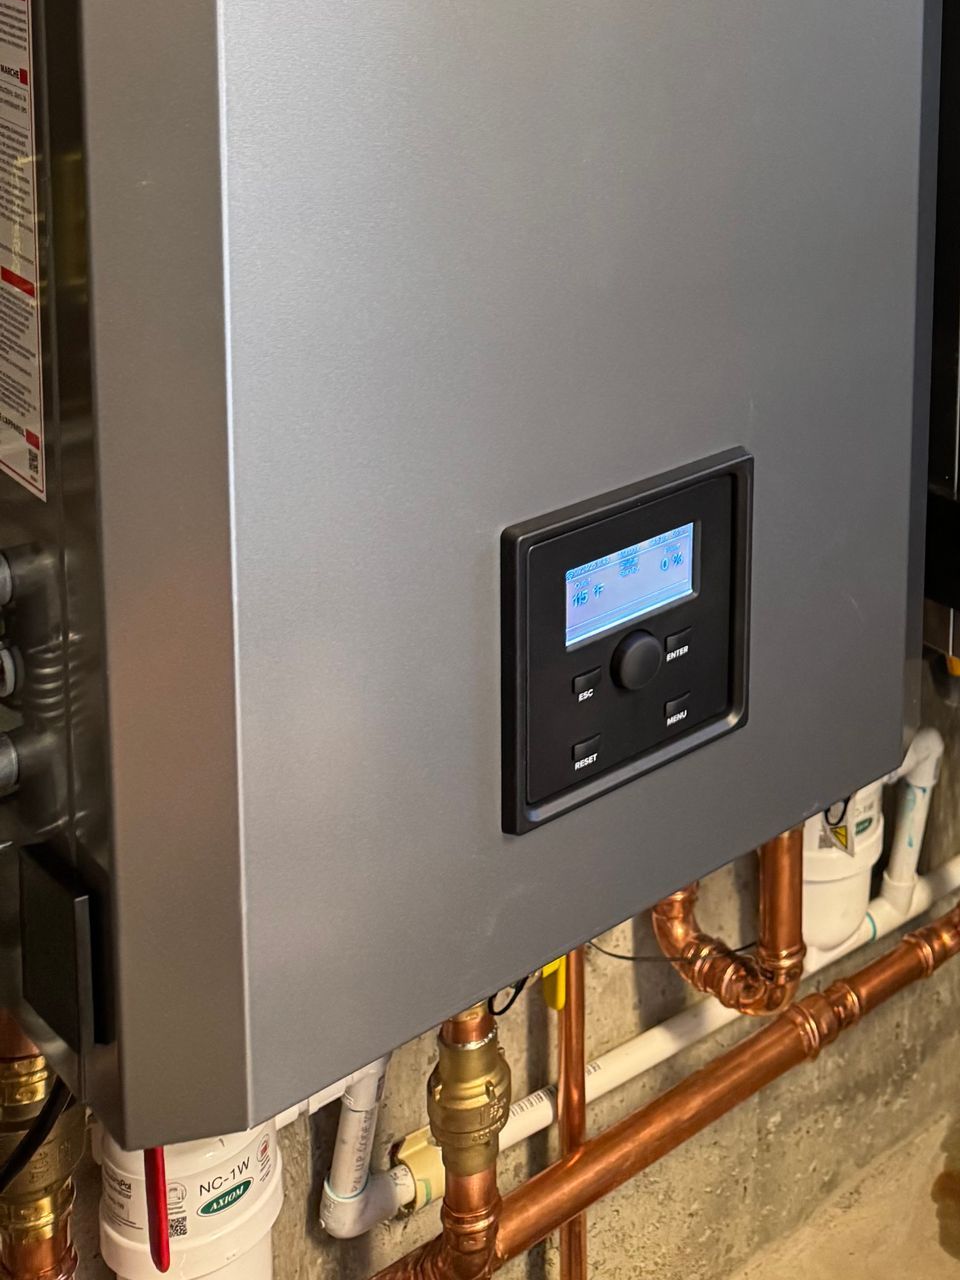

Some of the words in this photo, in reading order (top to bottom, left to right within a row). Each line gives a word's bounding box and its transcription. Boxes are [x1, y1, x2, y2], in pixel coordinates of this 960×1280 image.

[666, 645, 689, 662] ENTER
[578, 688, 594, 702] ESC
[666, 709, 687, 727] MENU
[574, 753, 598, 771] RESET
[199, 1156, 250, 1196] NC-1W
[209, 1185, 244, 1212] AXIOM
